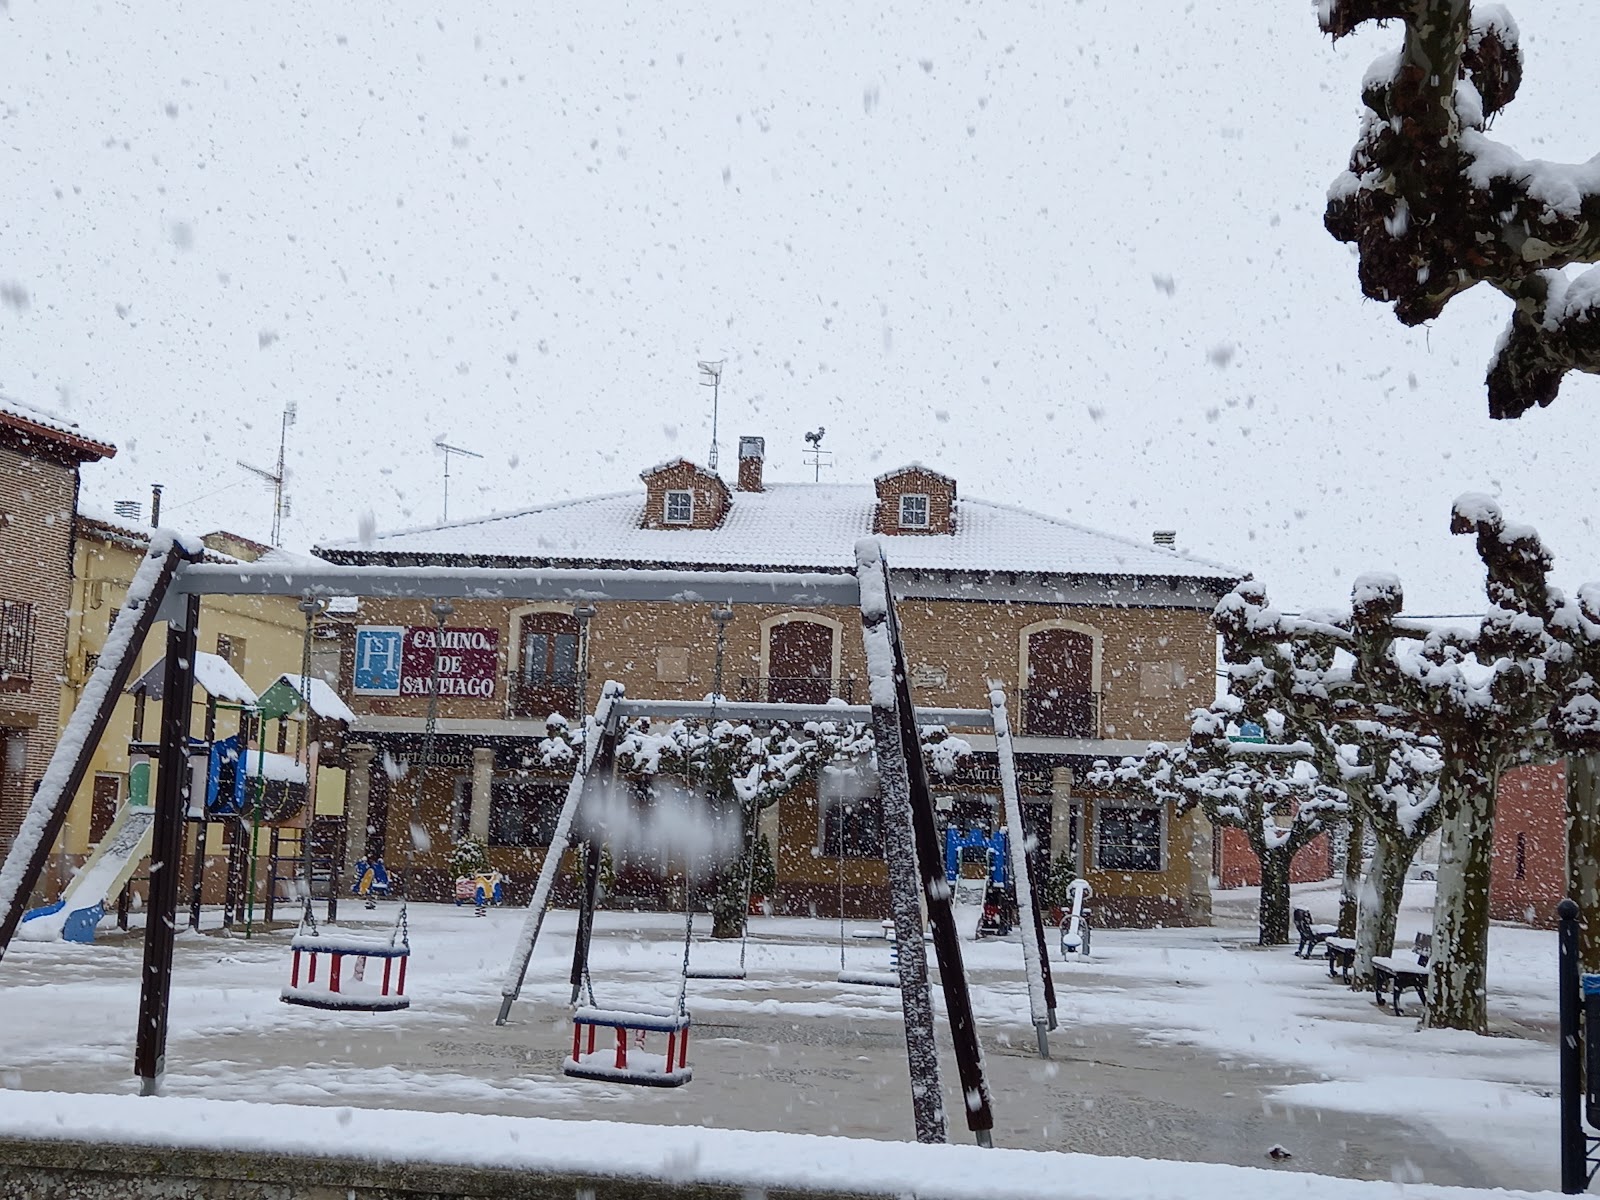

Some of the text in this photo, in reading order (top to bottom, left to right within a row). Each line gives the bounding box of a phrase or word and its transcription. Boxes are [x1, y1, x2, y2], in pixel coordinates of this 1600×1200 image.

[413, 631, 485, 650] CAMINO
[438, 656, 462, 673] DE
[402, 676, 494, 696] SANTIAGO
